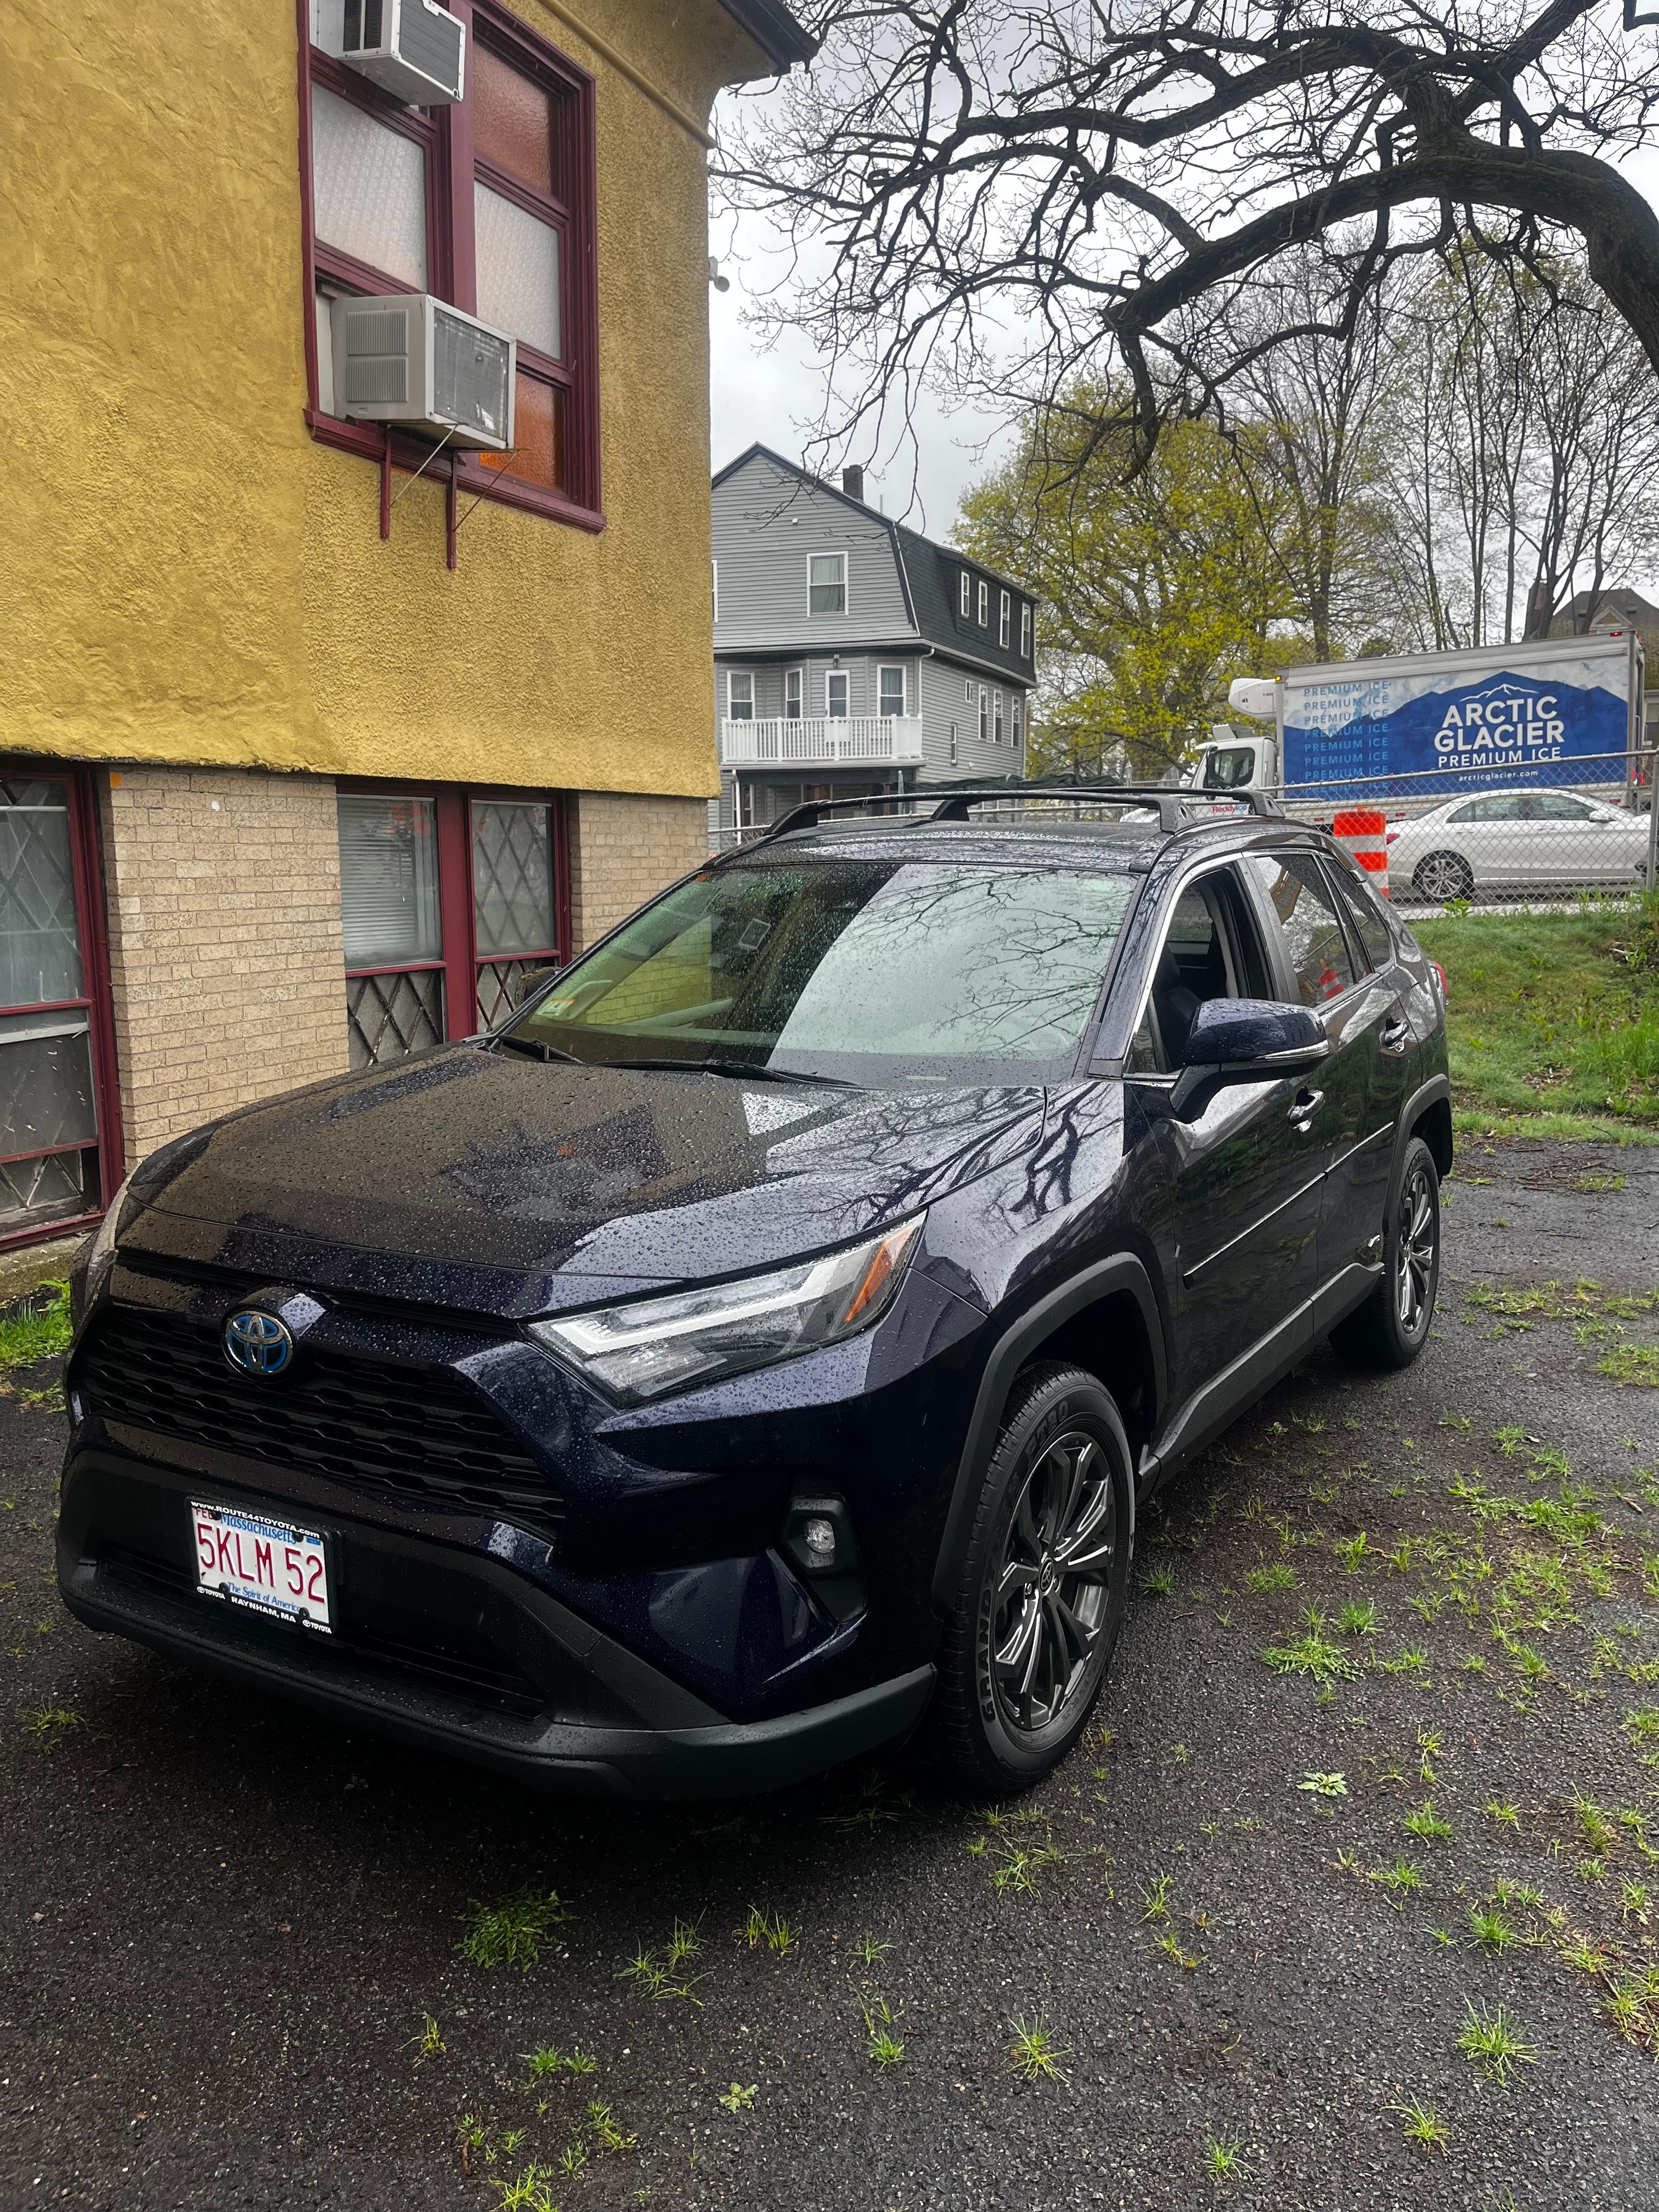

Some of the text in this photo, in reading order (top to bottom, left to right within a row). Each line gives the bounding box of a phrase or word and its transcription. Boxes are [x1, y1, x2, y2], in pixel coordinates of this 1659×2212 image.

[1304, 680, 1389, 697] PREMIUM ICE
[1304, 695, 1389, 711] PREMIUM ICE
[1304, 709, 1389, 725] PREMIUM ICE
[1442, 696, 1558, 729] ARCTIC
[1304, 723, 1389, 739] PREMIUM ICE
[1434, 720, 1565, 752] GLACIER
[1305, 737, 1389, 753] PREMIUM ICE
[1305, 751, 1389, 766] PREMIUM ICE
[1438, 747, 1561, 768] PREMIUM ICE
[1305, 765, 1389, 780] PREMIUM ICE
[1459, 770, 1538, 782] arcticglacier.com
[191, 1501, 320, 1539] www.ROUTE44TOYOTA.com
[221, 1514, 297, 1545] Massachusetts
[204, 1588, 225, 1600] TOYOTA
[227, 1582, 240, 1595] The
[242, 1586, 261, 1601] Spirit
[263, 1594, 270, 1606] of
[231, 1596, 296, 1623] RAYNHAM, MA
[310, 1622, 332, 1634] TOYOTA
